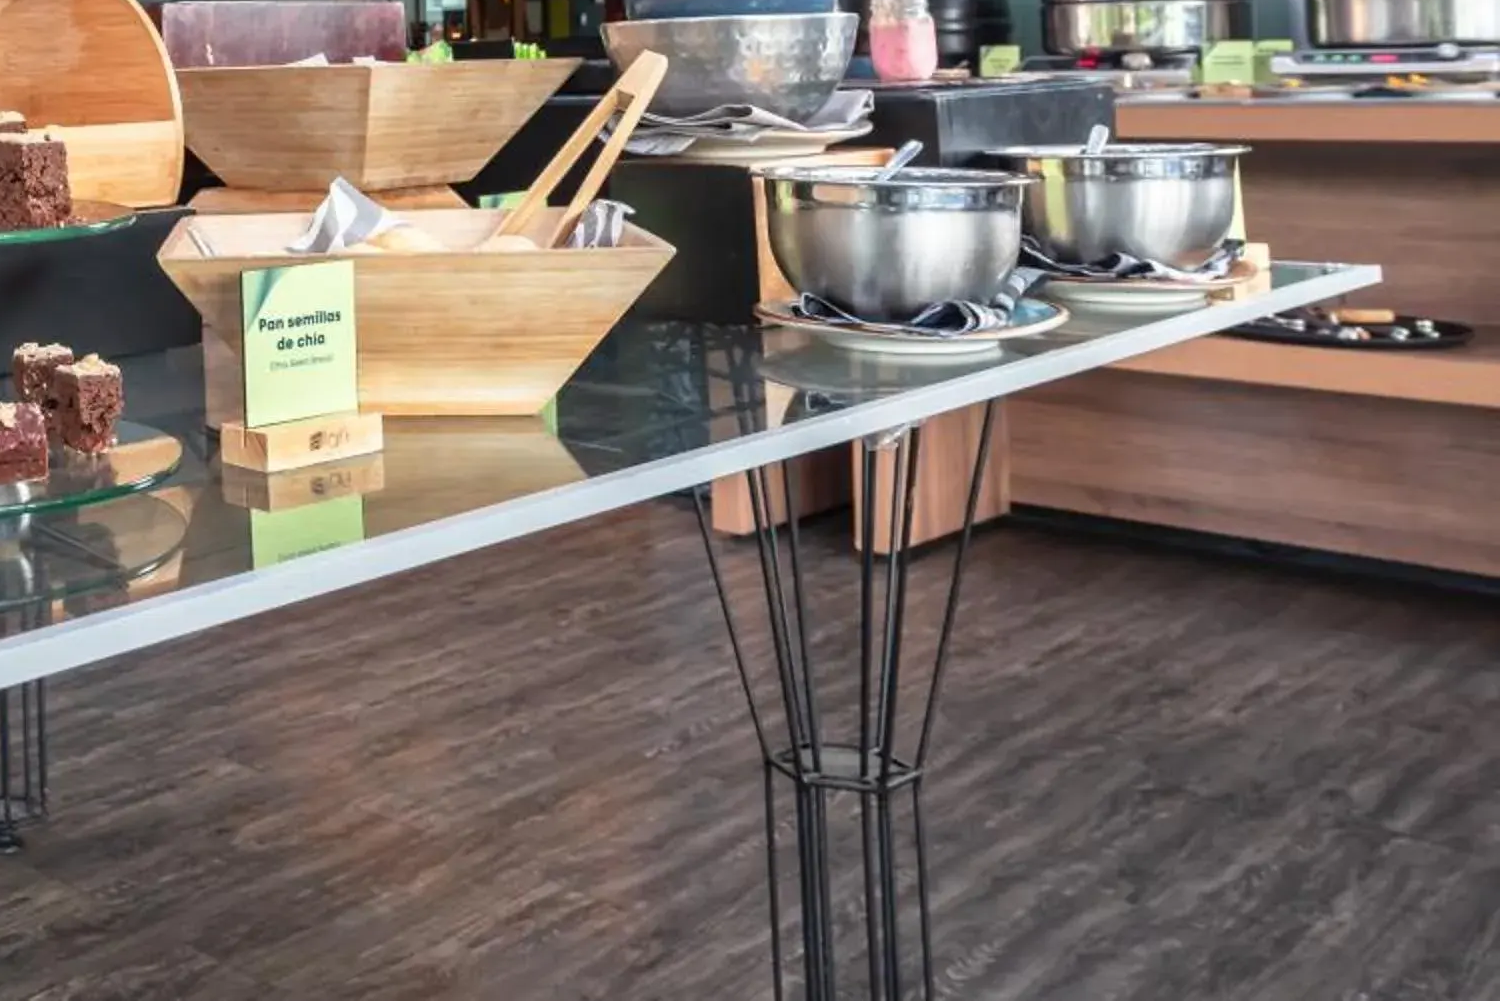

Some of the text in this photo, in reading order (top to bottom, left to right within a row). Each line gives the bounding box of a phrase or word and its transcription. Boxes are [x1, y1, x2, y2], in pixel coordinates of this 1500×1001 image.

[259, 310, 341, 332] Pan semillas
[277, 337, 294, 350] de
